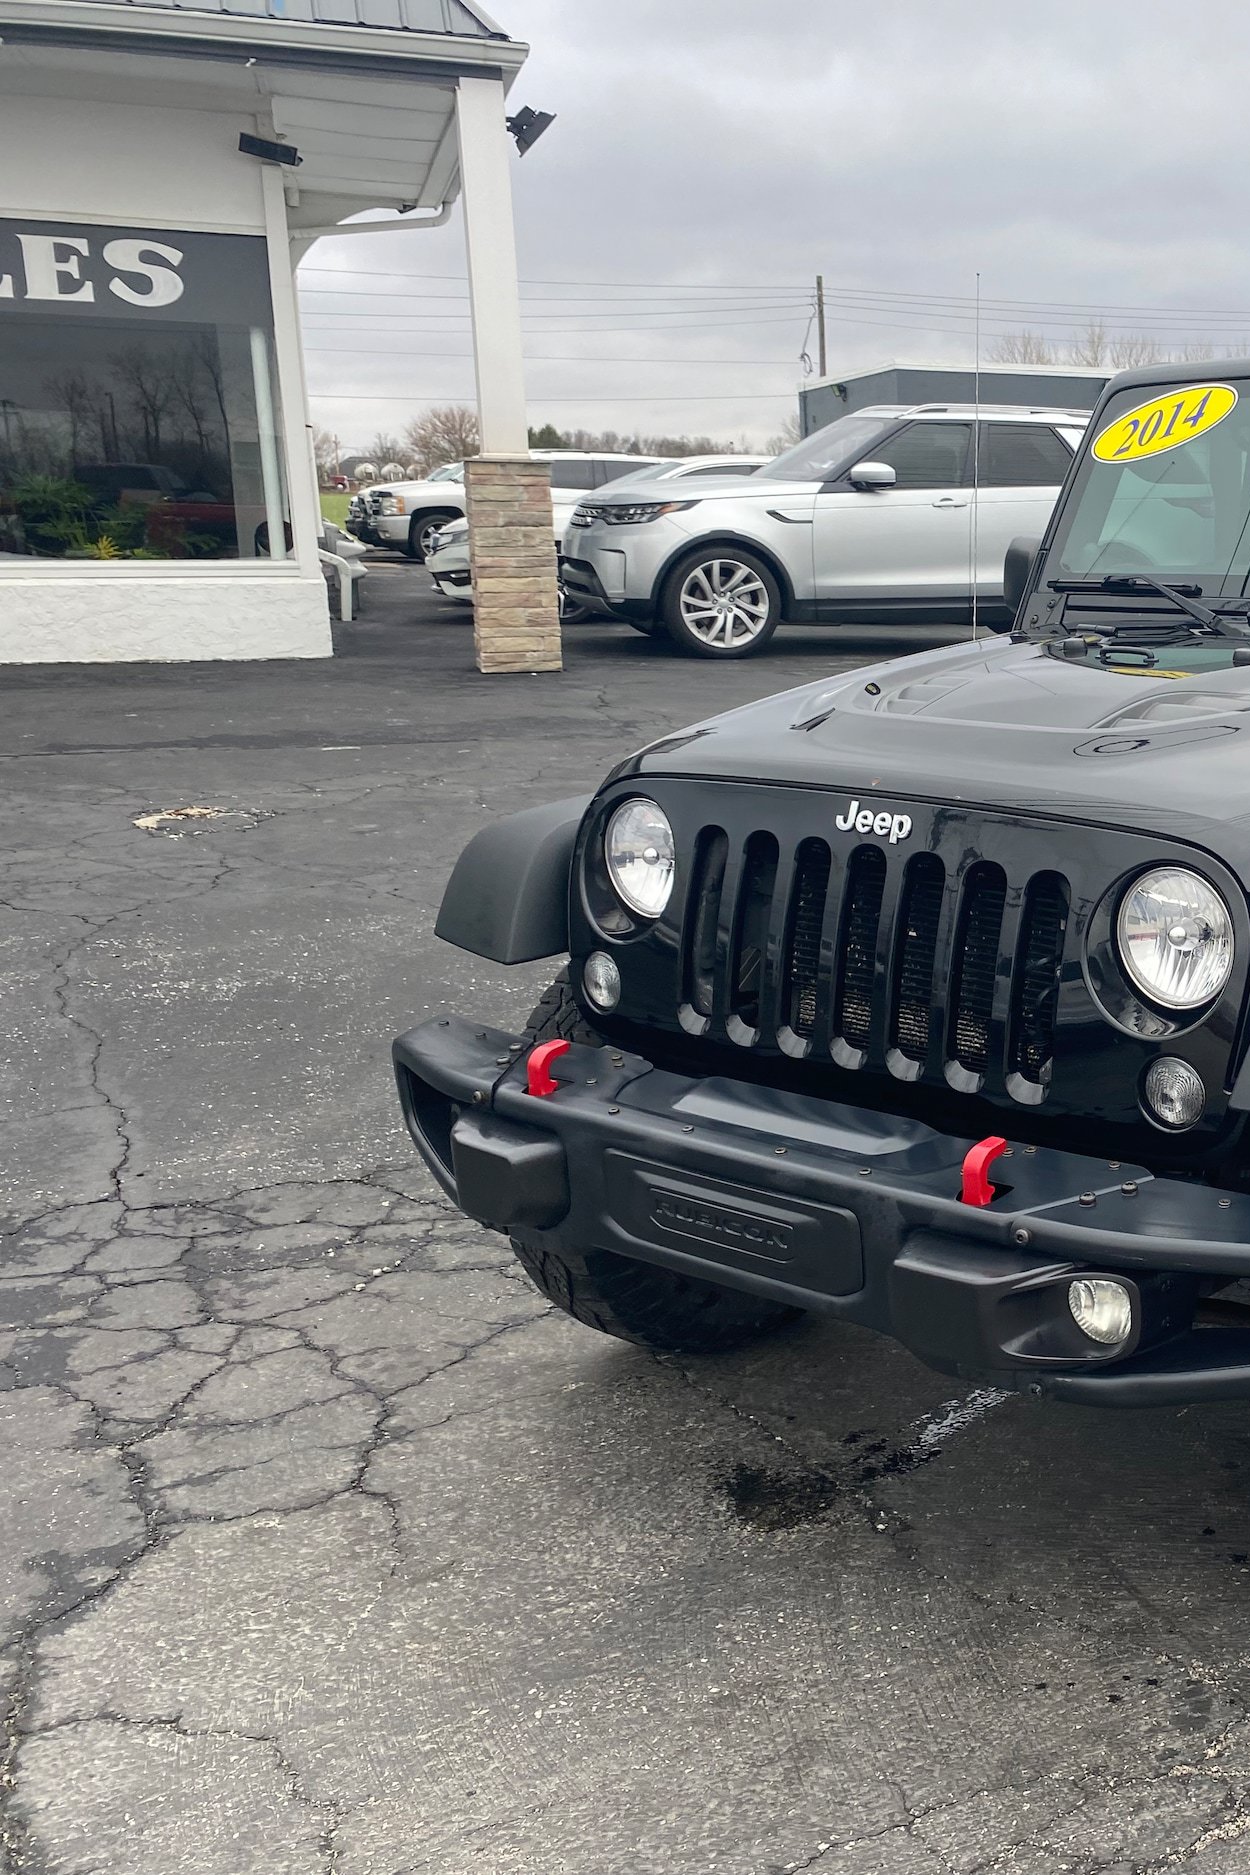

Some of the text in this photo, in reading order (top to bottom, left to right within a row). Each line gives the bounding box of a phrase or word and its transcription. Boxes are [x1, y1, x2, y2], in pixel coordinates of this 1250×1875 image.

[1112, 390, 1213, 457] 2014
[836, 801, 912, 844] Jeep
[655, 1199, 788, 1249] RUBICON
